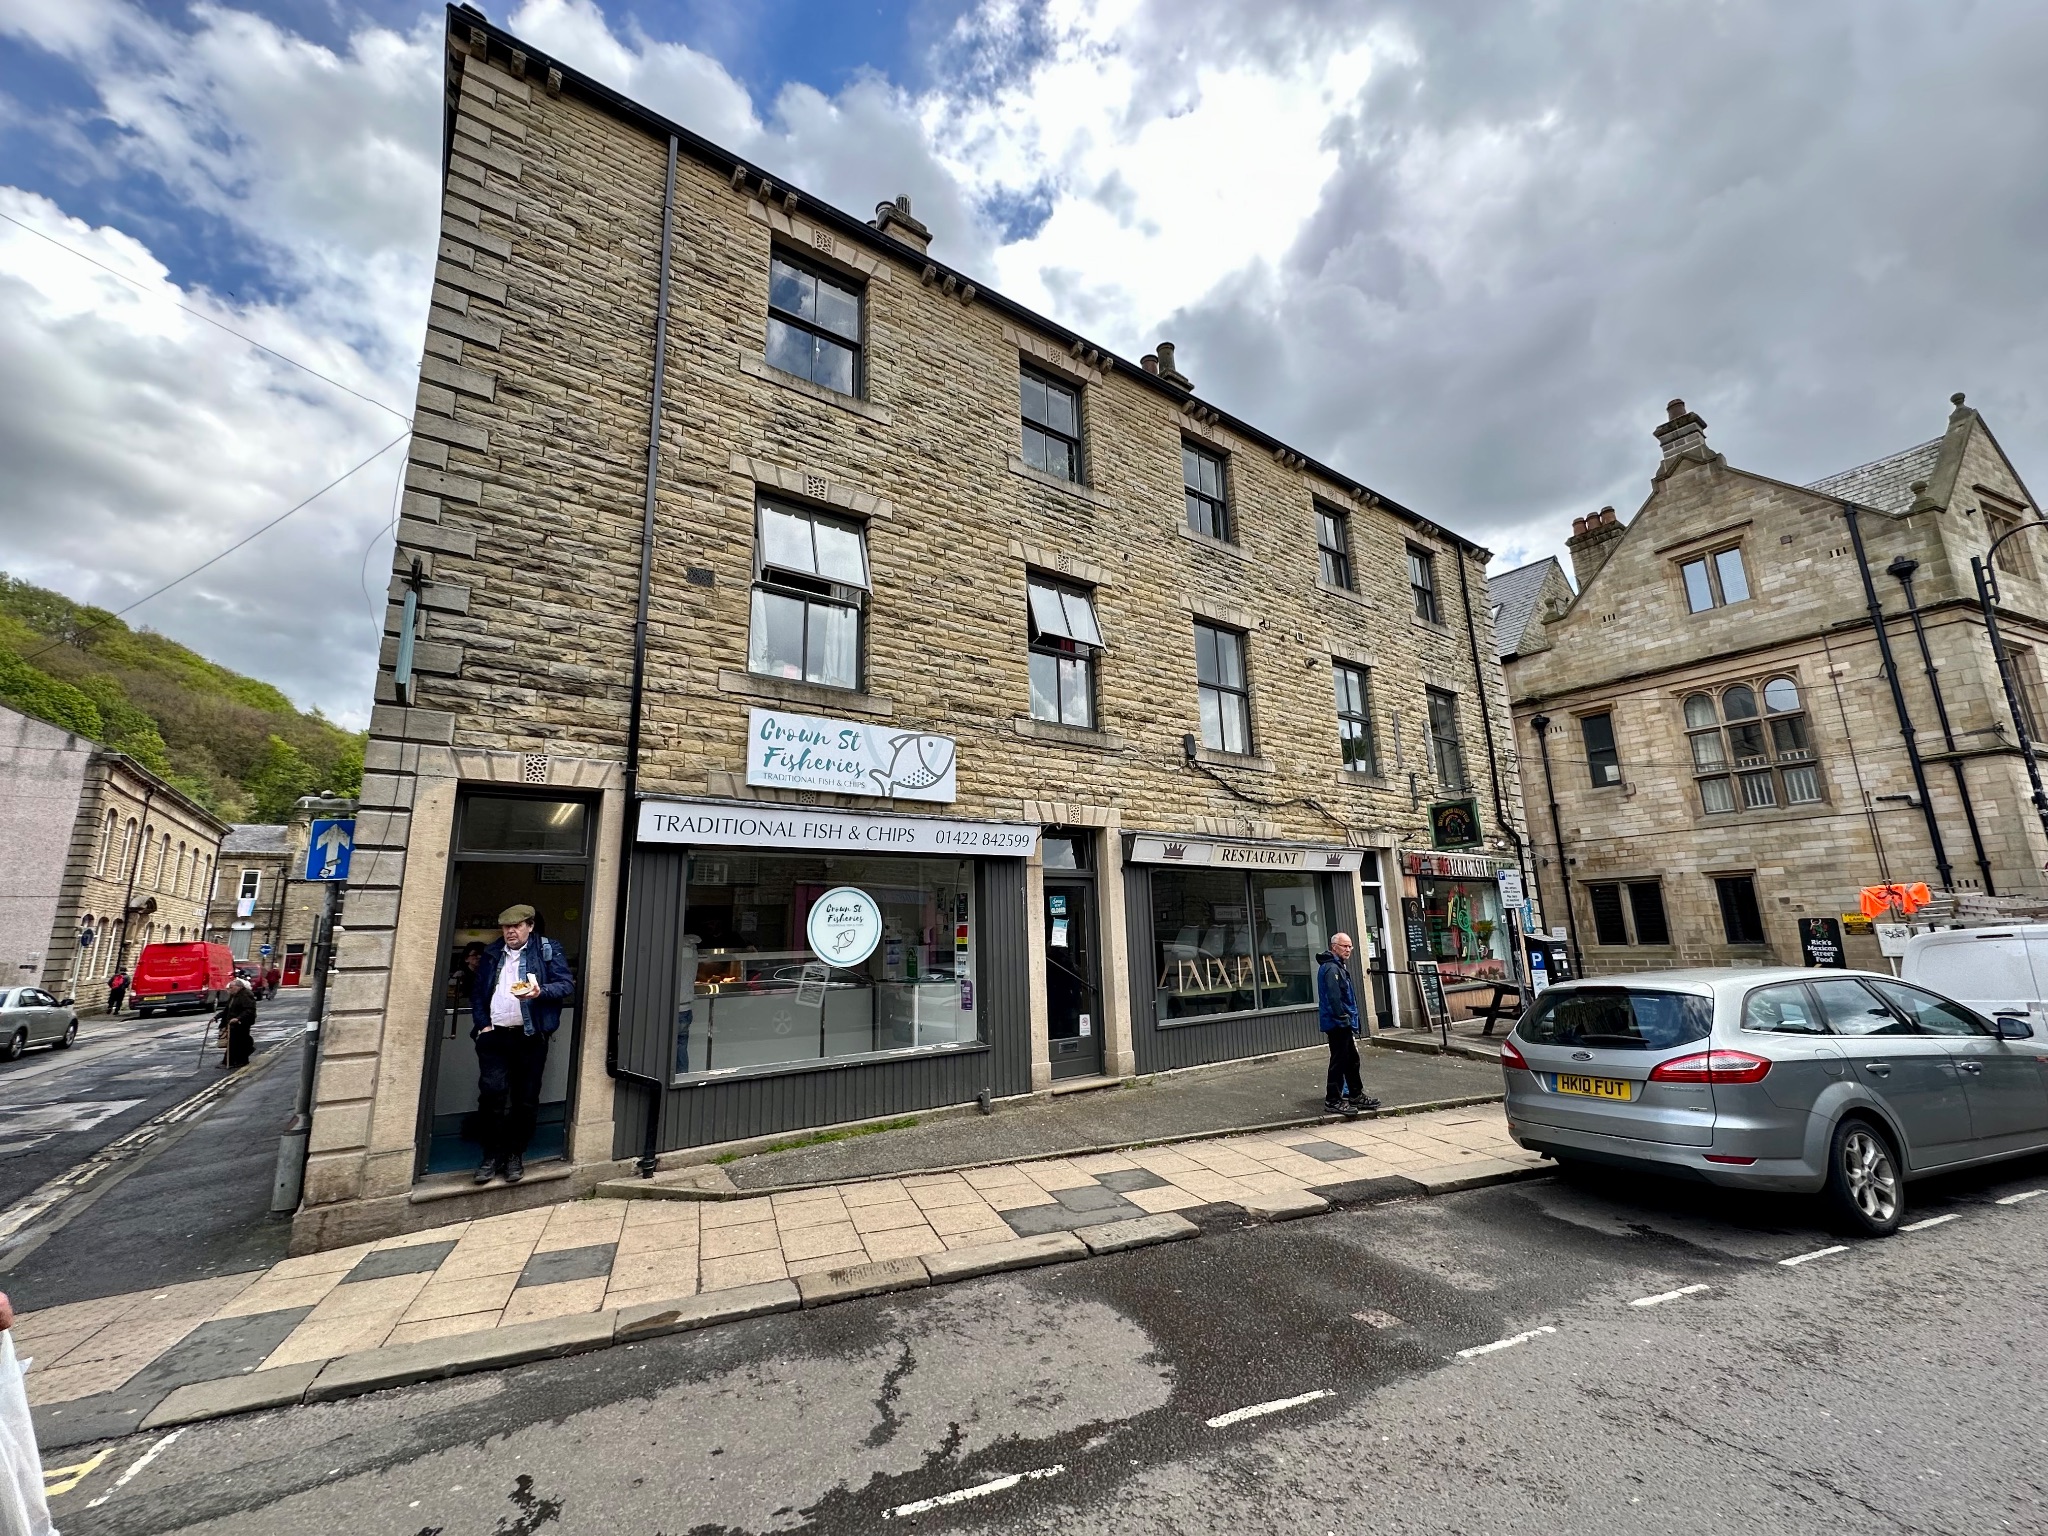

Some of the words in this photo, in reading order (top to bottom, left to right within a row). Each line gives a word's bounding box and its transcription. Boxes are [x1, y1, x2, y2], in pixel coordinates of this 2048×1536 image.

[760, 717, 831, 746] Crown
[838, 729, 862, 752] St
[763, 746, 866, 780] Fisheries
[763, 772, 817, 785] TRADITIONAL
[818, 777, 836, 787] FISH
[836, 779, 843, 787] &
[844, 779, 866, 789] CHIPS
[653, 814, 797, 838] TRADITIONAL
[803, 822, 842, 840] FISH
[848, 825, 861, 841] &
[866, 825, 915, 843] CHIPS
[935, 830, 978, 846] 01422
[982, 832, 1030, 848] 842599
[1221, 848, 1299, 865] RESTAURANT
[826, 903, 851, 913] Crown
[853, 904, 862, 913] St
[827, 913, 864, 923] Fisheries
[1531, 952, 1542, 967] P
[1561, 1075, 1591, 1092] HK10
[1594, 1080, 1624, 1097] FUT
